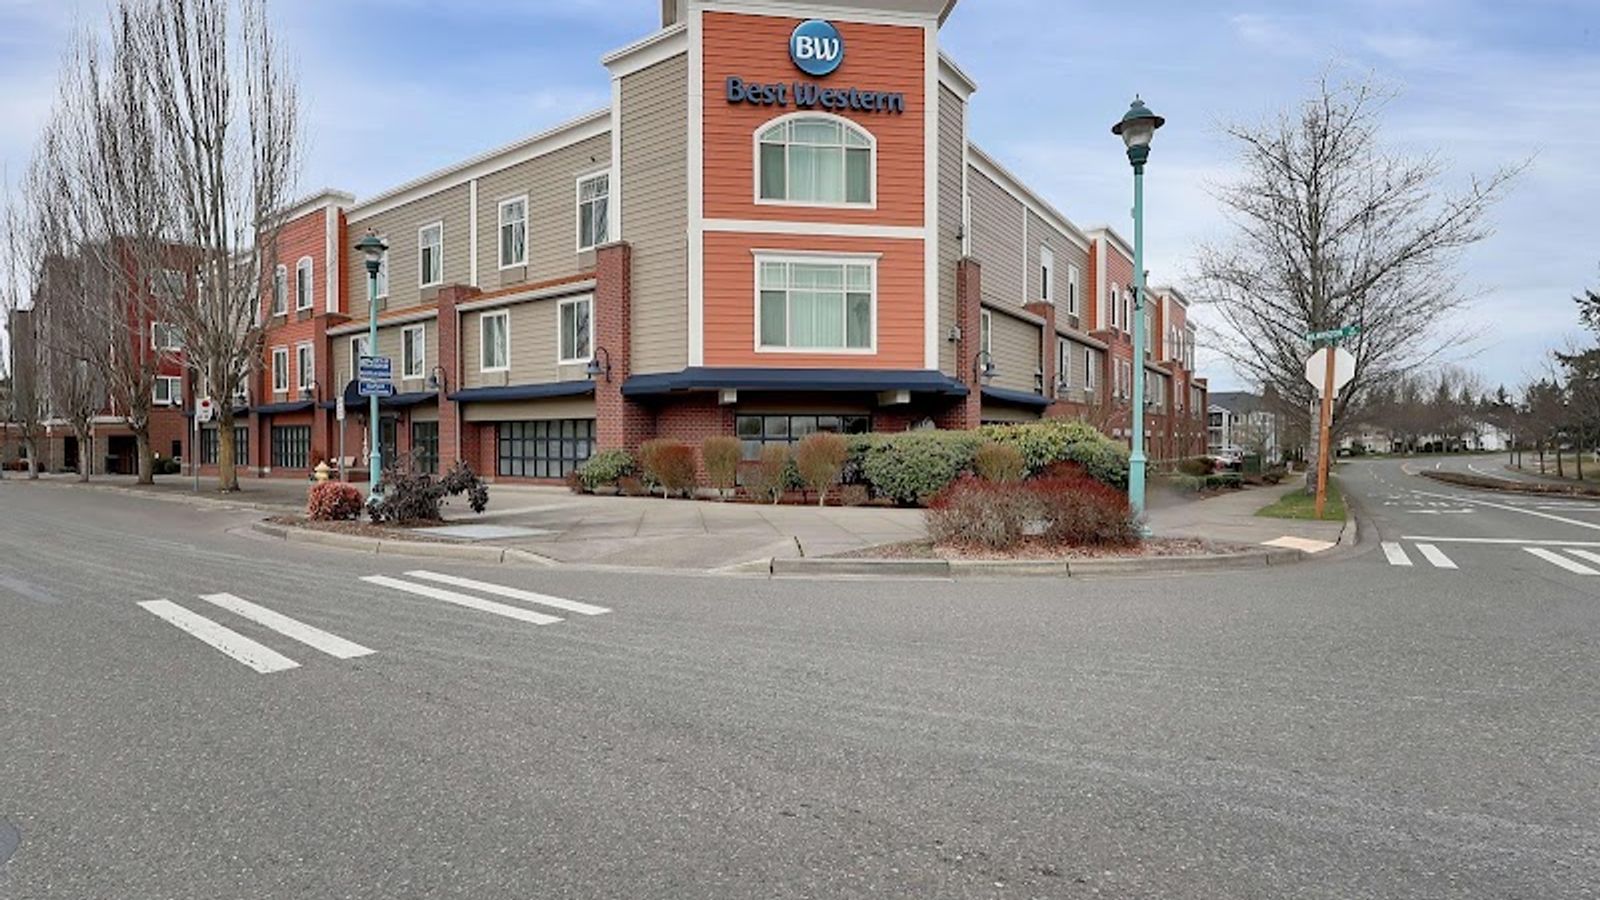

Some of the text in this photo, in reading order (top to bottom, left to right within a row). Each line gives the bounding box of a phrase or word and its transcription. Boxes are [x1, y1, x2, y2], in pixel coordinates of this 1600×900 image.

[796, 36, 840, 61] BW
[726, 76, 904, 113] Best Western
